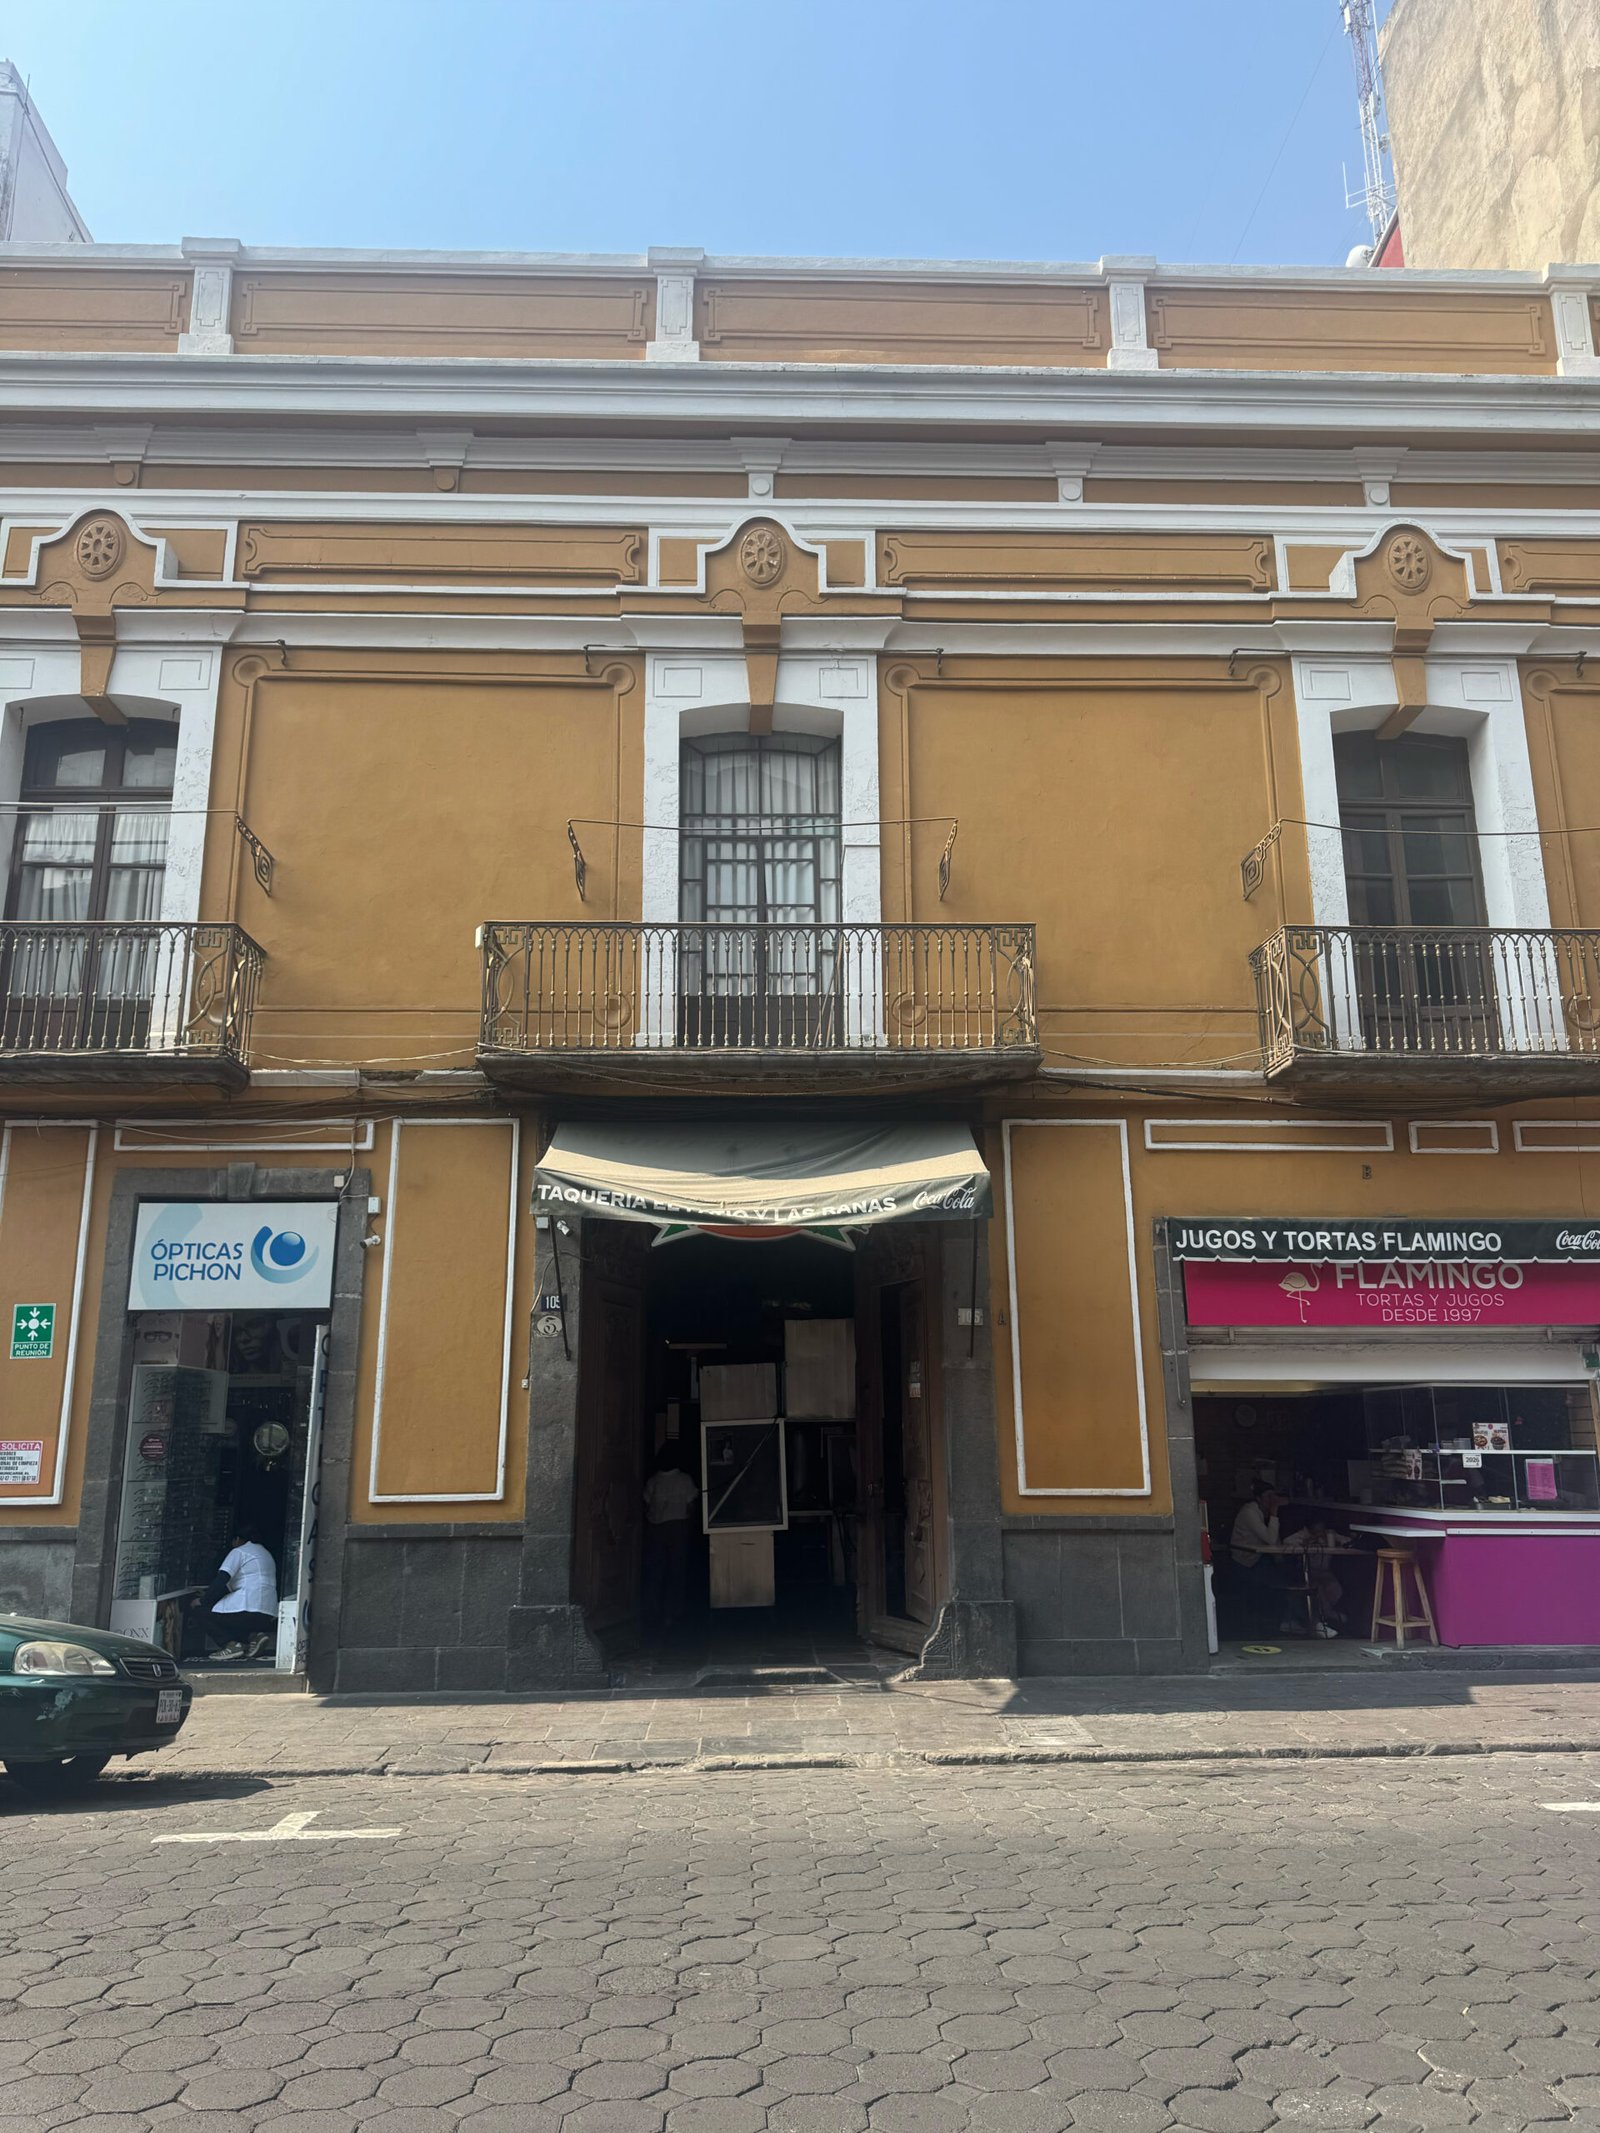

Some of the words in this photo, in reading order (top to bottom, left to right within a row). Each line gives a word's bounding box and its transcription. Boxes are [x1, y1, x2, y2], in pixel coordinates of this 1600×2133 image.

[537, 1184, 648, 1210] TAQUERIA
[774, 1207, 816, 1222] LAS
[822, 1197, 897, 1216] RANAS
[150, 1238, 244, 1260] ÓPTICAS
[1176, 1229, 1257, 1250] JUGOS
[1261, 1230, 1278, 1250] Y
[1283, 1231, 1377, 1251] TORTAS
[1383, 1232, 1502, 1252] FLAMINGO
[153, 1263, 242, 1281] PICHON
[1335, 1263, 1524, 1290] FLAMINGO
[1356, 1293, 1424, 1307] TORTAS
[1429, 1293, 1440, 1307] Y
[1446, 1293, 1505, 1307] JUGOS
[1382, 1308, 1438, 1322] DESDE
[1443, 1308, 1482, 1322] 1997
